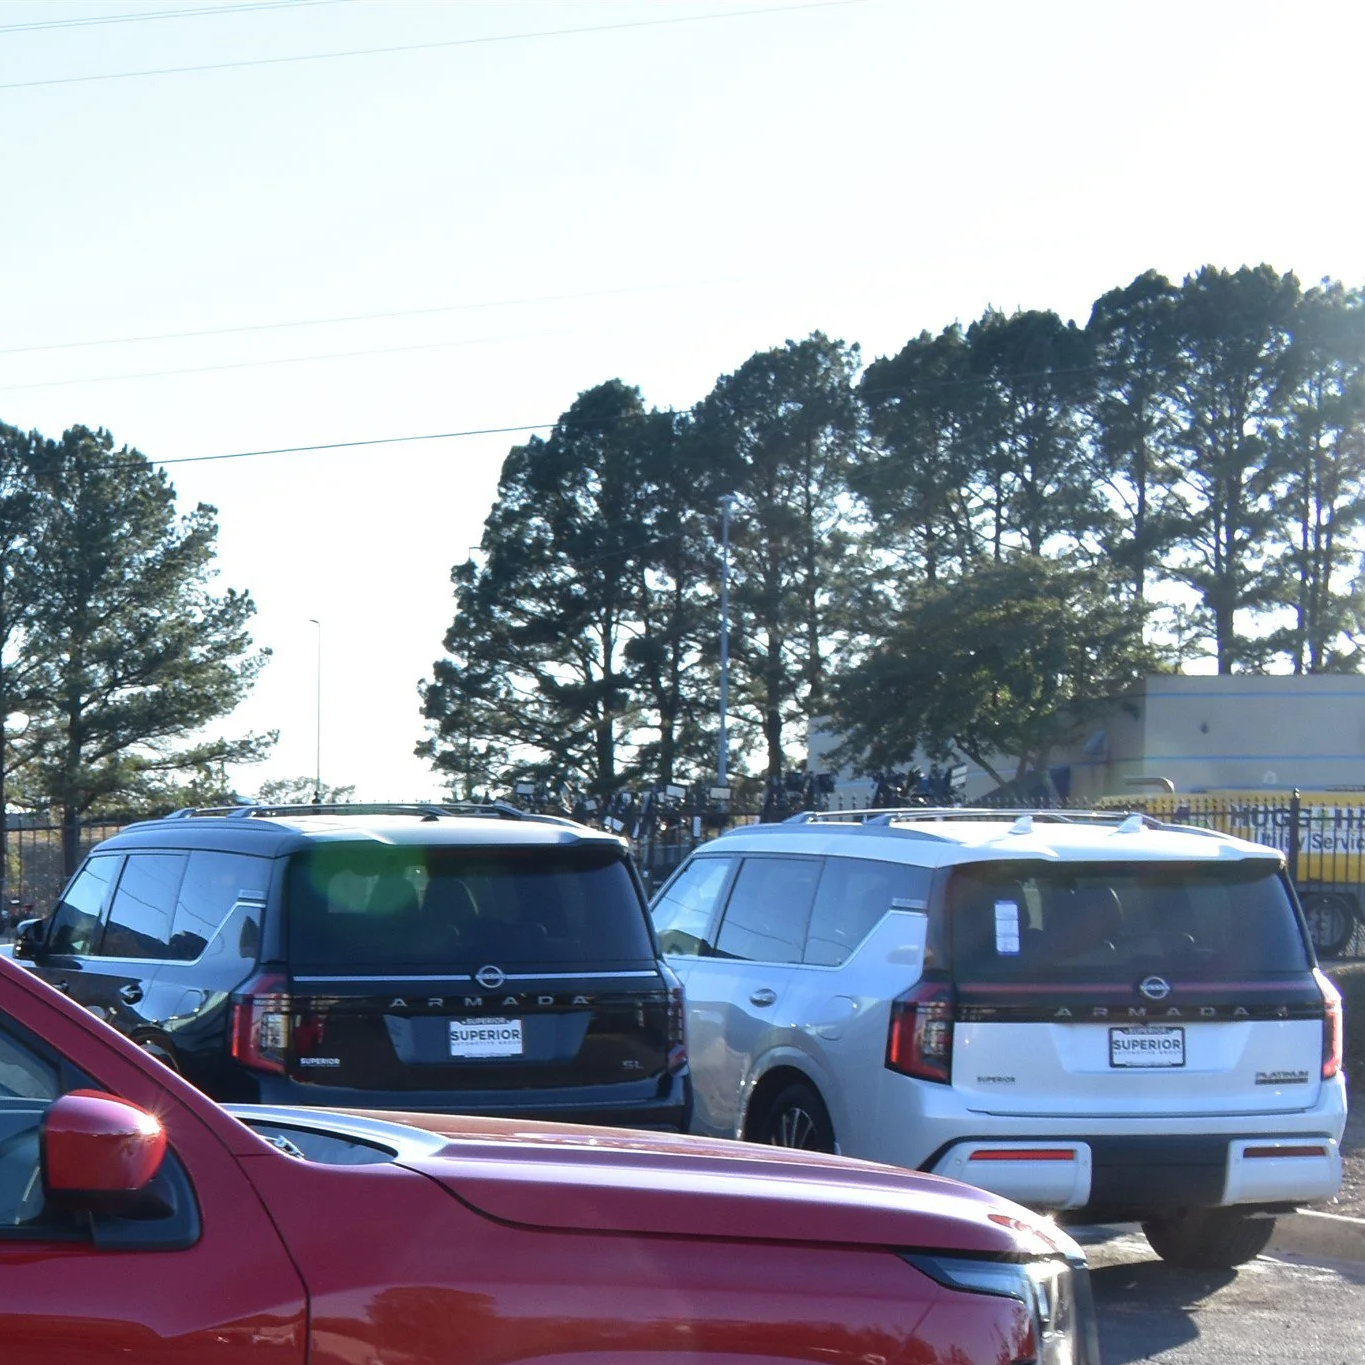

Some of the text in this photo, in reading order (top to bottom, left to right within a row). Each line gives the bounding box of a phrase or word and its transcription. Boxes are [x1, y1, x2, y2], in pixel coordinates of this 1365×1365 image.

[389, 995, 590, 1008] ARMADA
[1054, 1007, 1250, 1018] ARMADA
[451, 1029, 520, 1041] SUPERIOR
[1113, 1039, 1180, 1050] SUPERIOR
